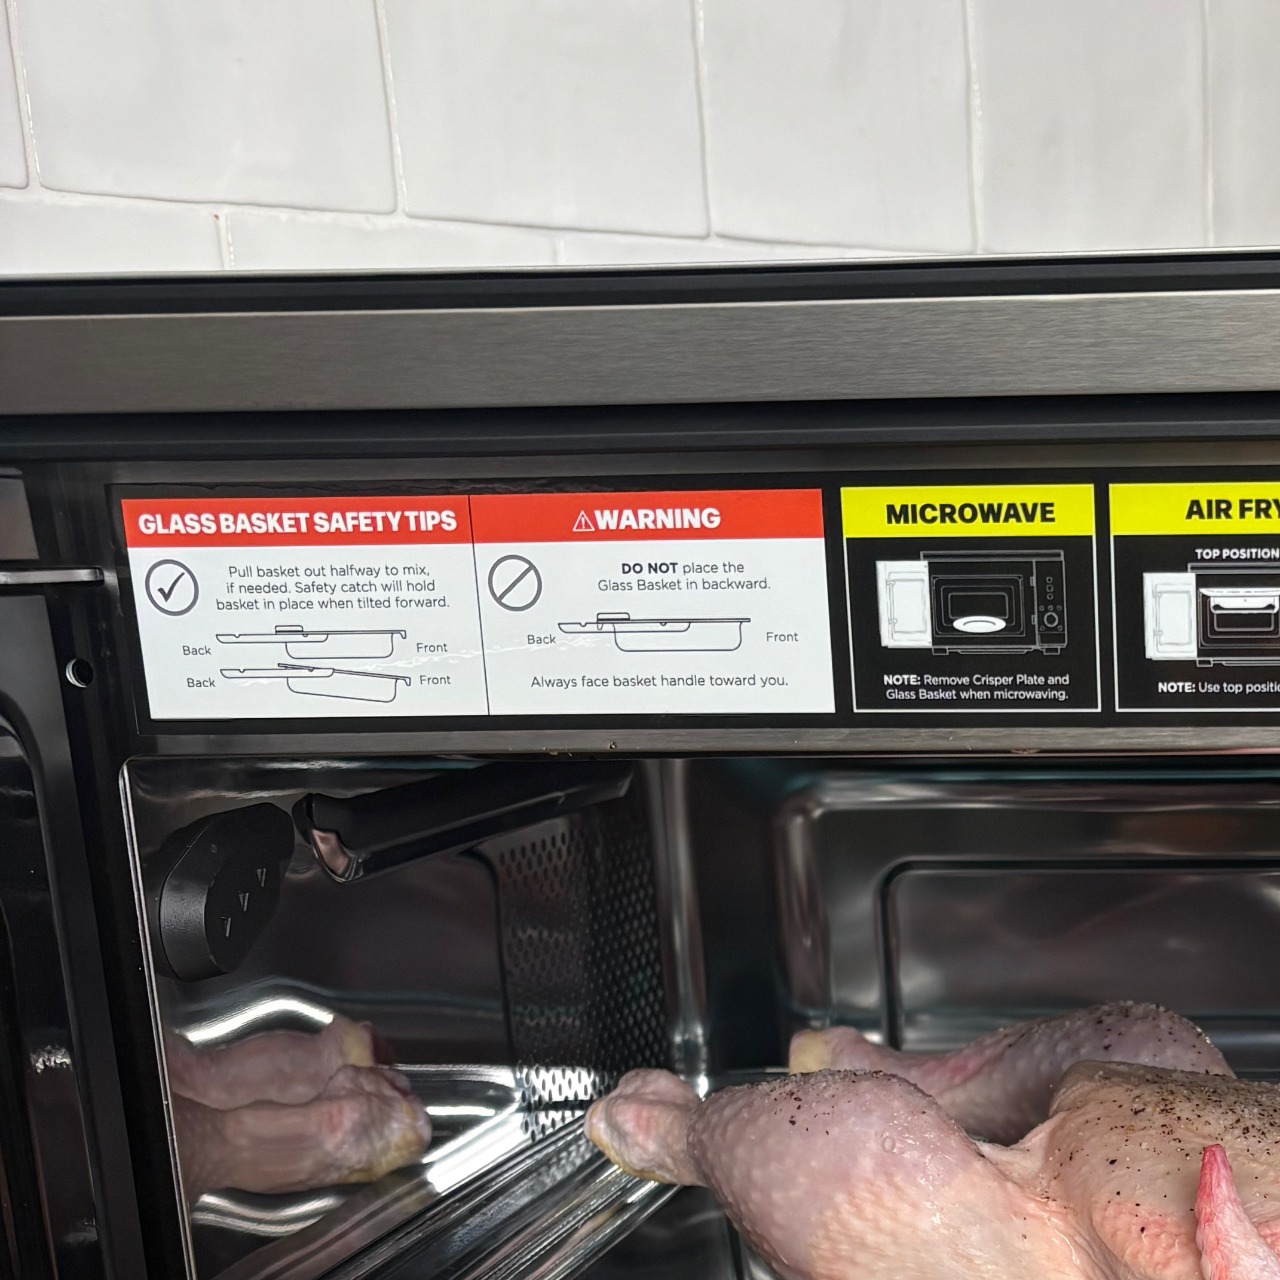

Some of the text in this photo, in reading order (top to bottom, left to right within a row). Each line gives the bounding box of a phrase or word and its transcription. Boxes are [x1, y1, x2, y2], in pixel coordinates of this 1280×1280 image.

[886, 502, 1055, 524] MICROWAVE
[1185, 498, 1232, 519] AIR
[138, 509, 457, 534] GLASS BASKET SAFETY TIPS
[594, 507, 721, 531] WARNING
[1195, 548, 1280, 559] TOP POSITION
[228, 564, 430, 578] Pull basket out halfway to mix,
[621, 561, 744, 575] DO NOT place the
[226, 579, 435, 595] if needed. Safety catch will hold
[597, 577, 770, 591] Glass Basket in backward.
[215, 595, 449, 611] basket in place when tilted forward.
[527, 633, 556, 644] Back
[766, 631, 798, 642] Front
[182, 645, 211, 655] Back
[416, 642, 448, 653] Front
[186, 677, 216, 687] Back
[419, 674, 451, 685] Front
[530, 673, 788, 689] Always face basket handle toward you.
[883, 673, 1069, 686] NOTE: Remove Crisper Plate and
[1157, 681, 1195, 692] NOTE:
[1198, 681, 1220, 692] Use
[1222, 682, 1243, 694] top
[885, 688, 1068, 701] Glass Basket when microwaving.
